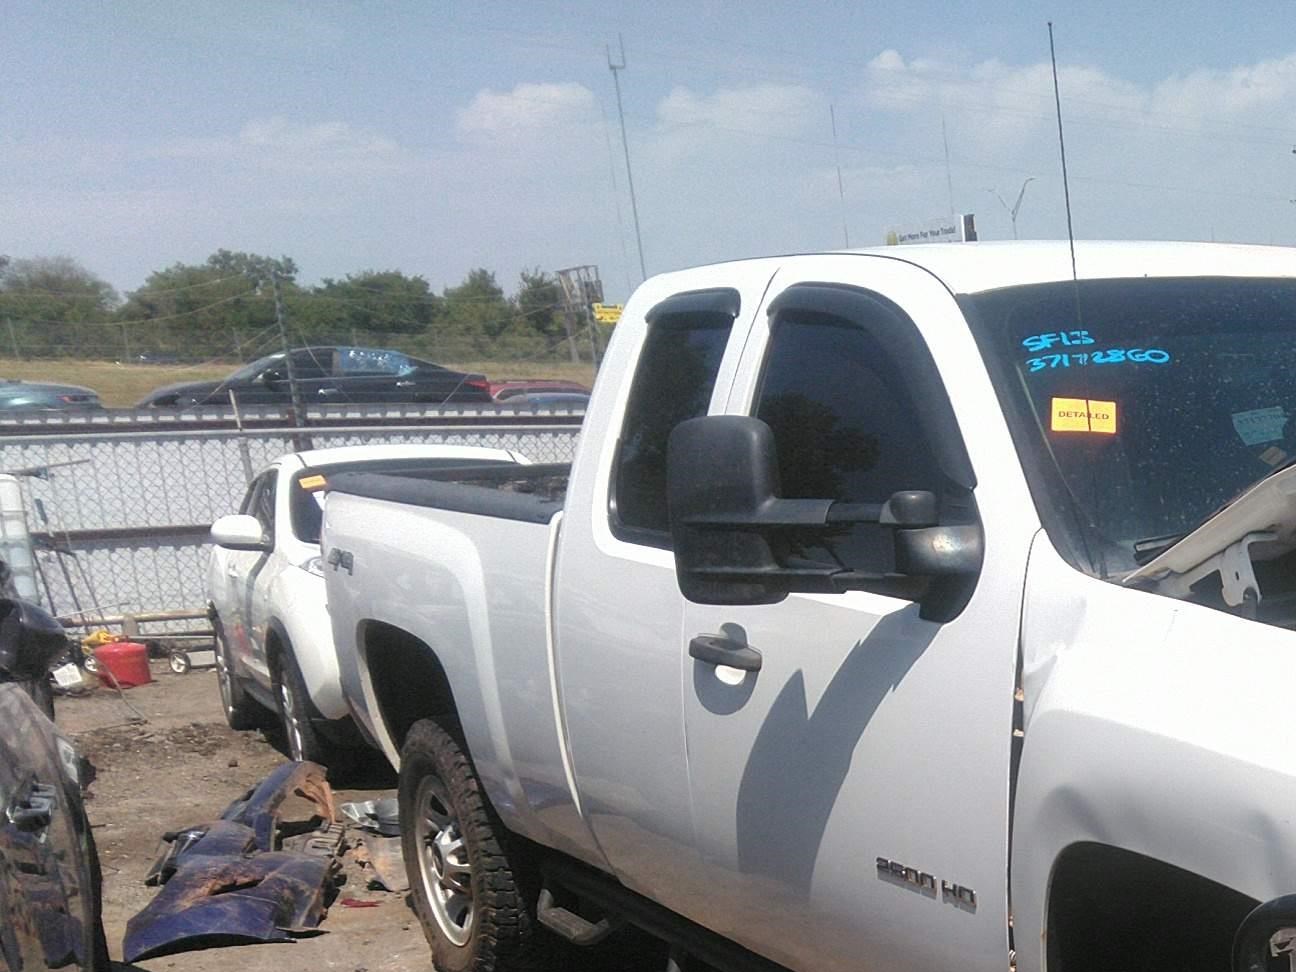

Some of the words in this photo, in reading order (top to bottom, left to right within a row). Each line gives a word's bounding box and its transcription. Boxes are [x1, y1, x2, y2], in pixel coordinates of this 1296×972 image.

[1058, 410, 1110, 421] DETALED
[876, 856, 937, 900] 2500
[941, 879, 977, 915] HD
